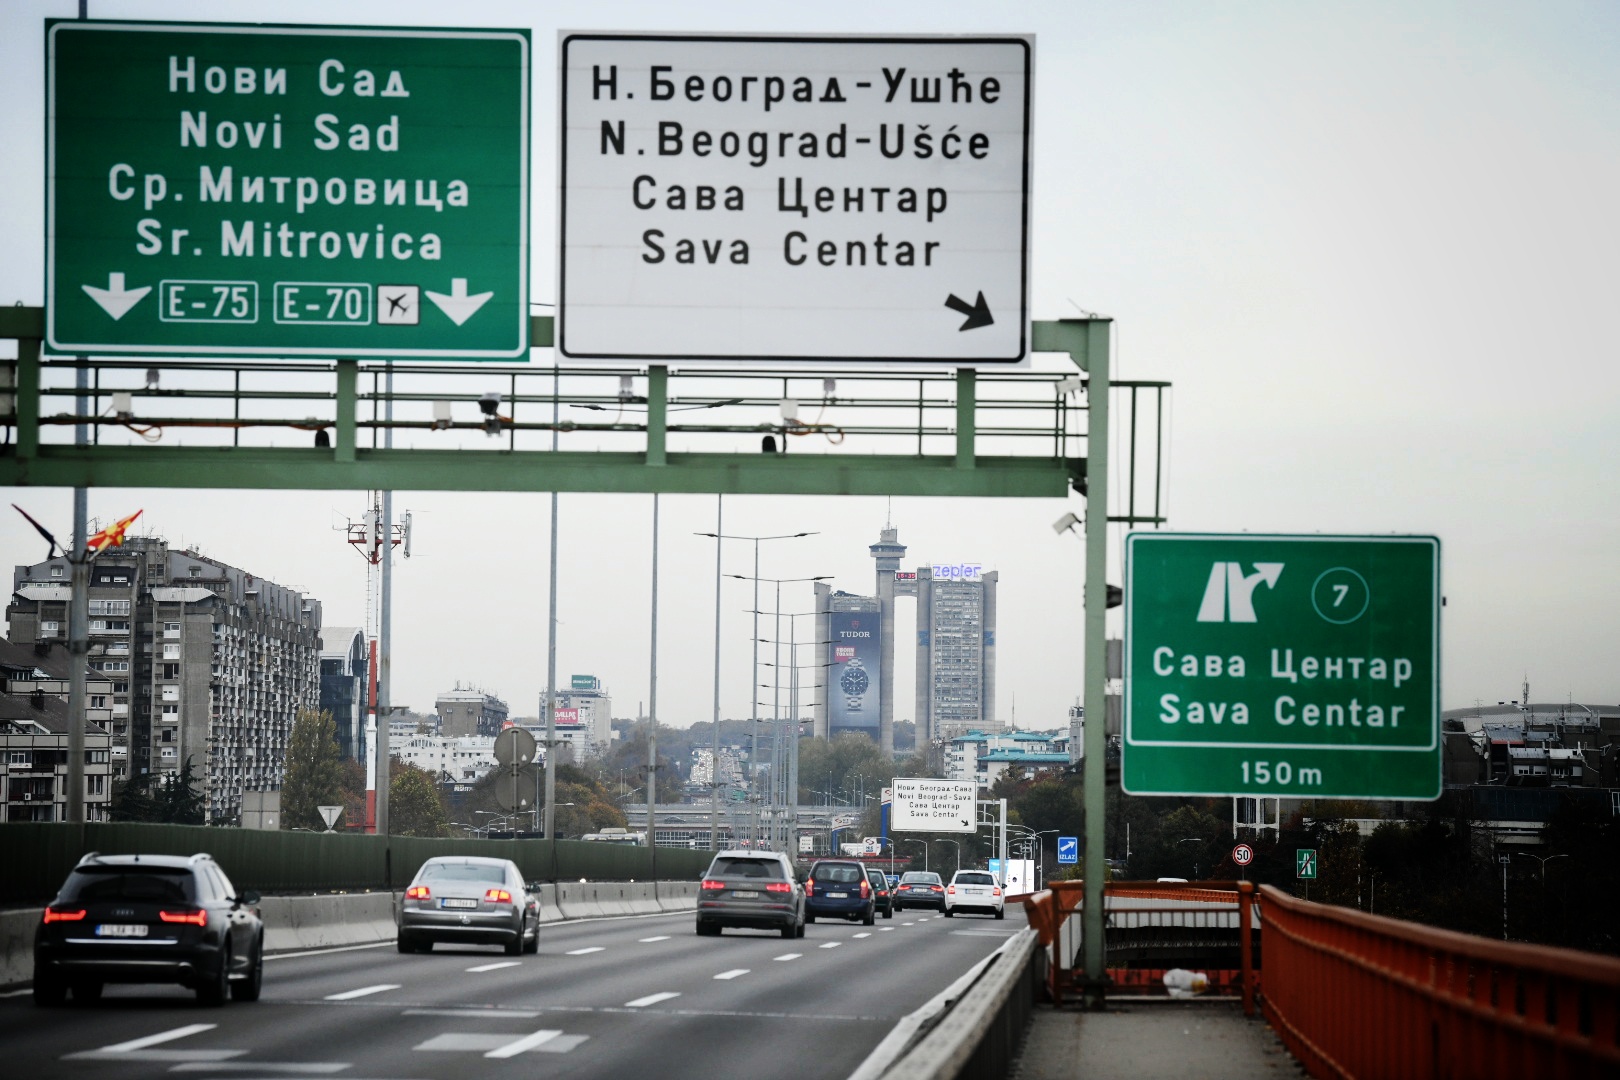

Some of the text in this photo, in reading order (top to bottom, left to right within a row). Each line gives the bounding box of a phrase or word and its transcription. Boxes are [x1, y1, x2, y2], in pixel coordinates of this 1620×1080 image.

[168, 55, 410, 99] Нови Сад
[180, 111, 399, 153] Novi Sad
[108, 163, 469, 213] Ср. Митровица
[632, 174, 948, 222] Сава Центар
[136, 218, 442, 260] Sr. Mitrovica
[641, 229, 941, 267] Sava Centar
[168, 286, 250, 319] E-75
[283, 287, 364, 320] E-70
[933, 564, 981, 580] zepter
[1332, 584, 1349, 607] 7
[1153, 646, 1413, 688] Сава Центар
[1159, 693, 1406, 727] Sava Centar
[932, 802, 960, 810] Центар
[1237, 850, 1249, 860] 50
